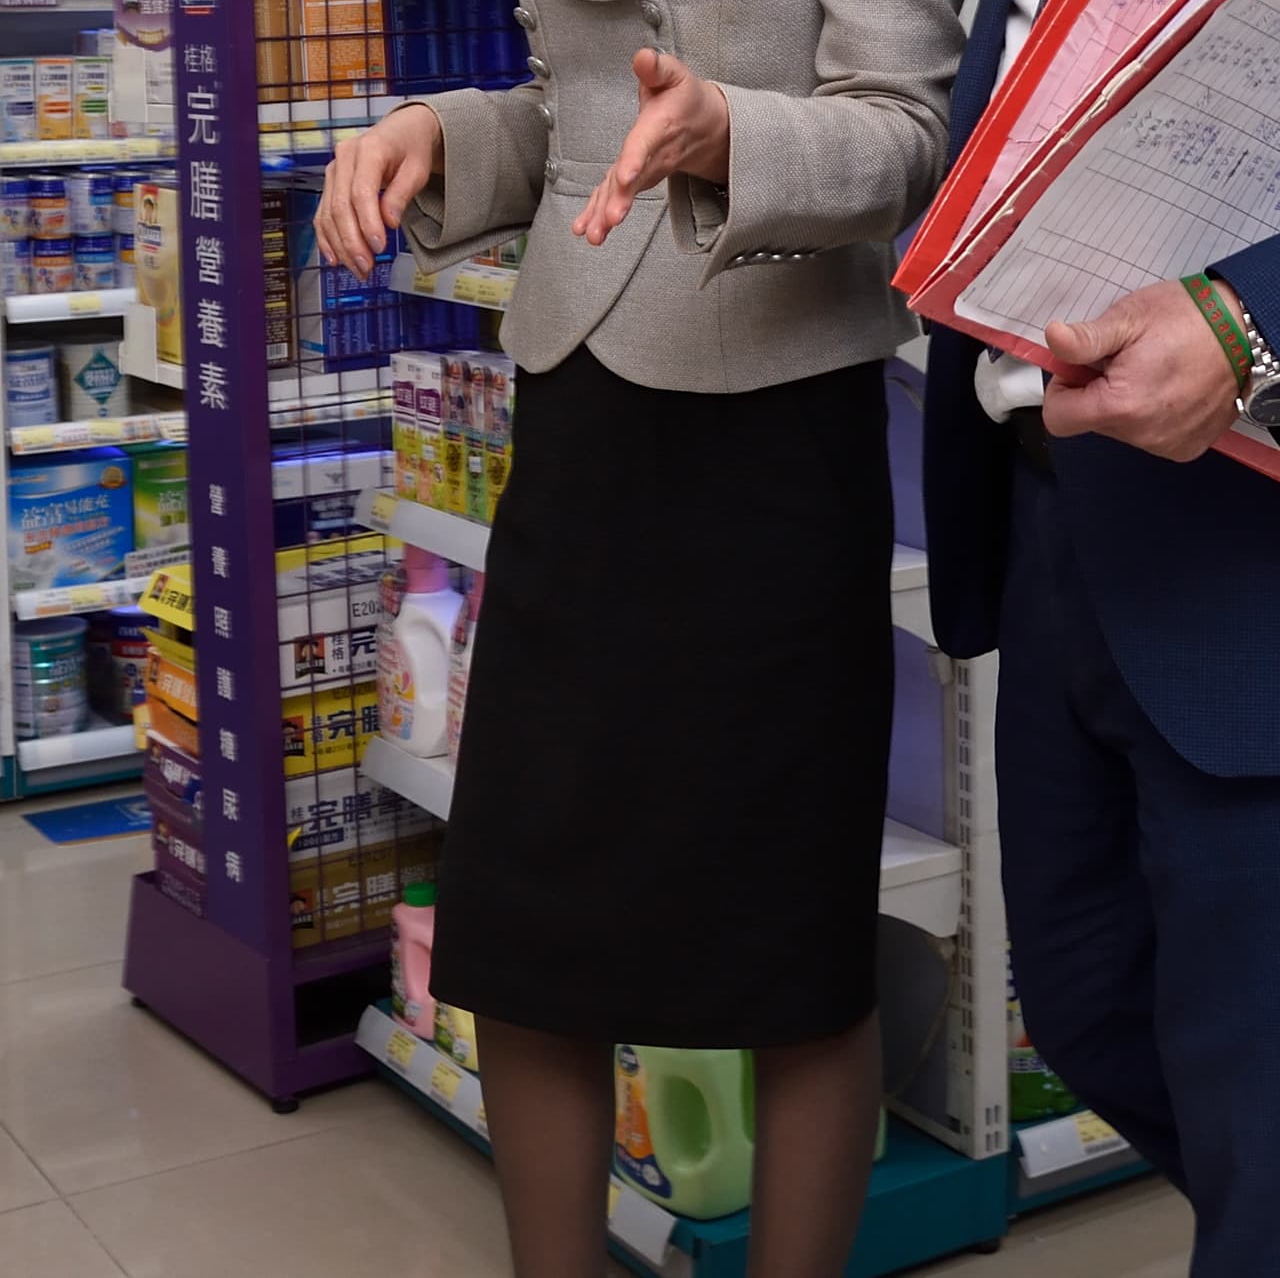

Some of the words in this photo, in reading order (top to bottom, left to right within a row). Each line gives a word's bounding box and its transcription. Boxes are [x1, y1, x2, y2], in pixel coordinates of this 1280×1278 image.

[184, 43, 218, 74] 桂格
[185, 86, 231, 412] 完膳營養素
